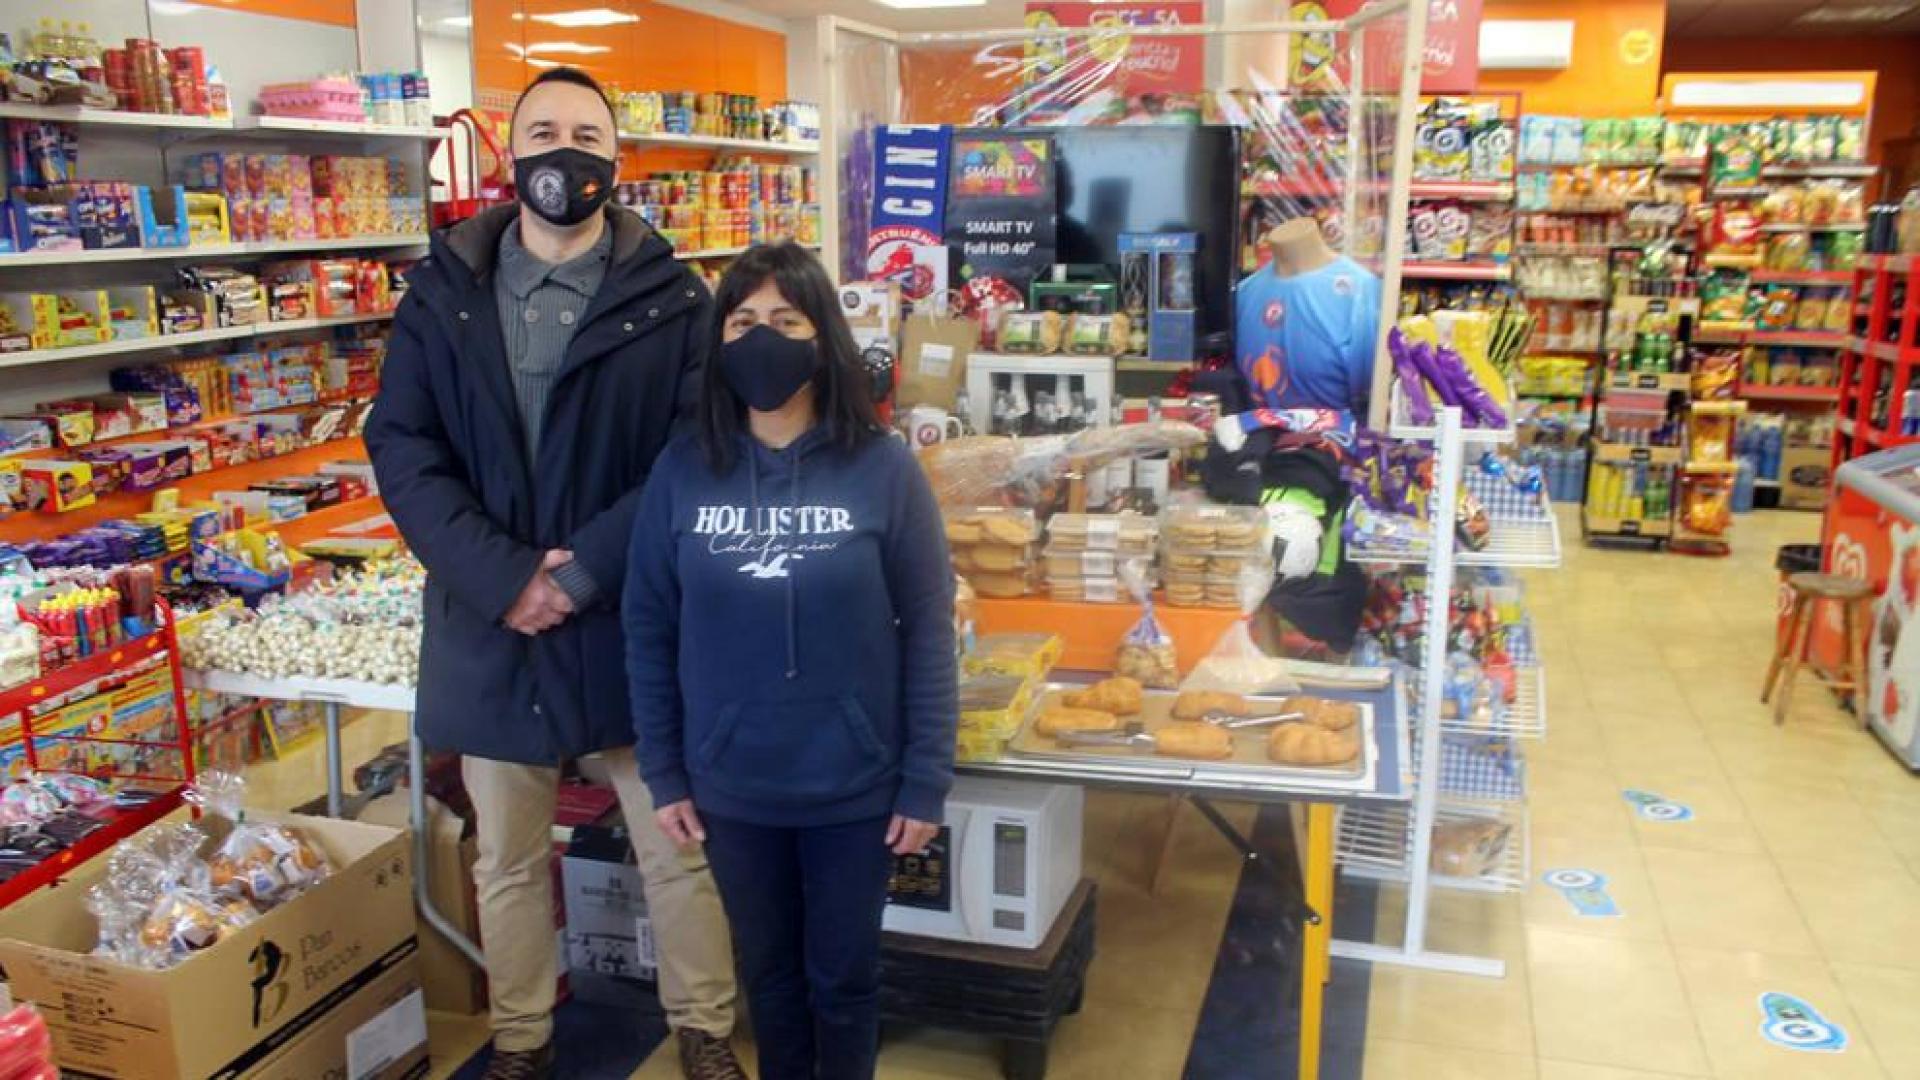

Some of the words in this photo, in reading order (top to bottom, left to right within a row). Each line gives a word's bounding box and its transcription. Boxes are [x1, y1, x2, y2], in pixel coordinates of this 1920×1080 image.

[963, 165, 1012, 179] SMART
[1016, 165, 1037, 179] TV
[965, 220, 1012, 234] SMART
[1014, 220, 1034, 234] TV
[963, 241, 988, 255] Full
[990, 241, 1010, 255] HD
[693, 505, 854, 535] HOLLISTER
